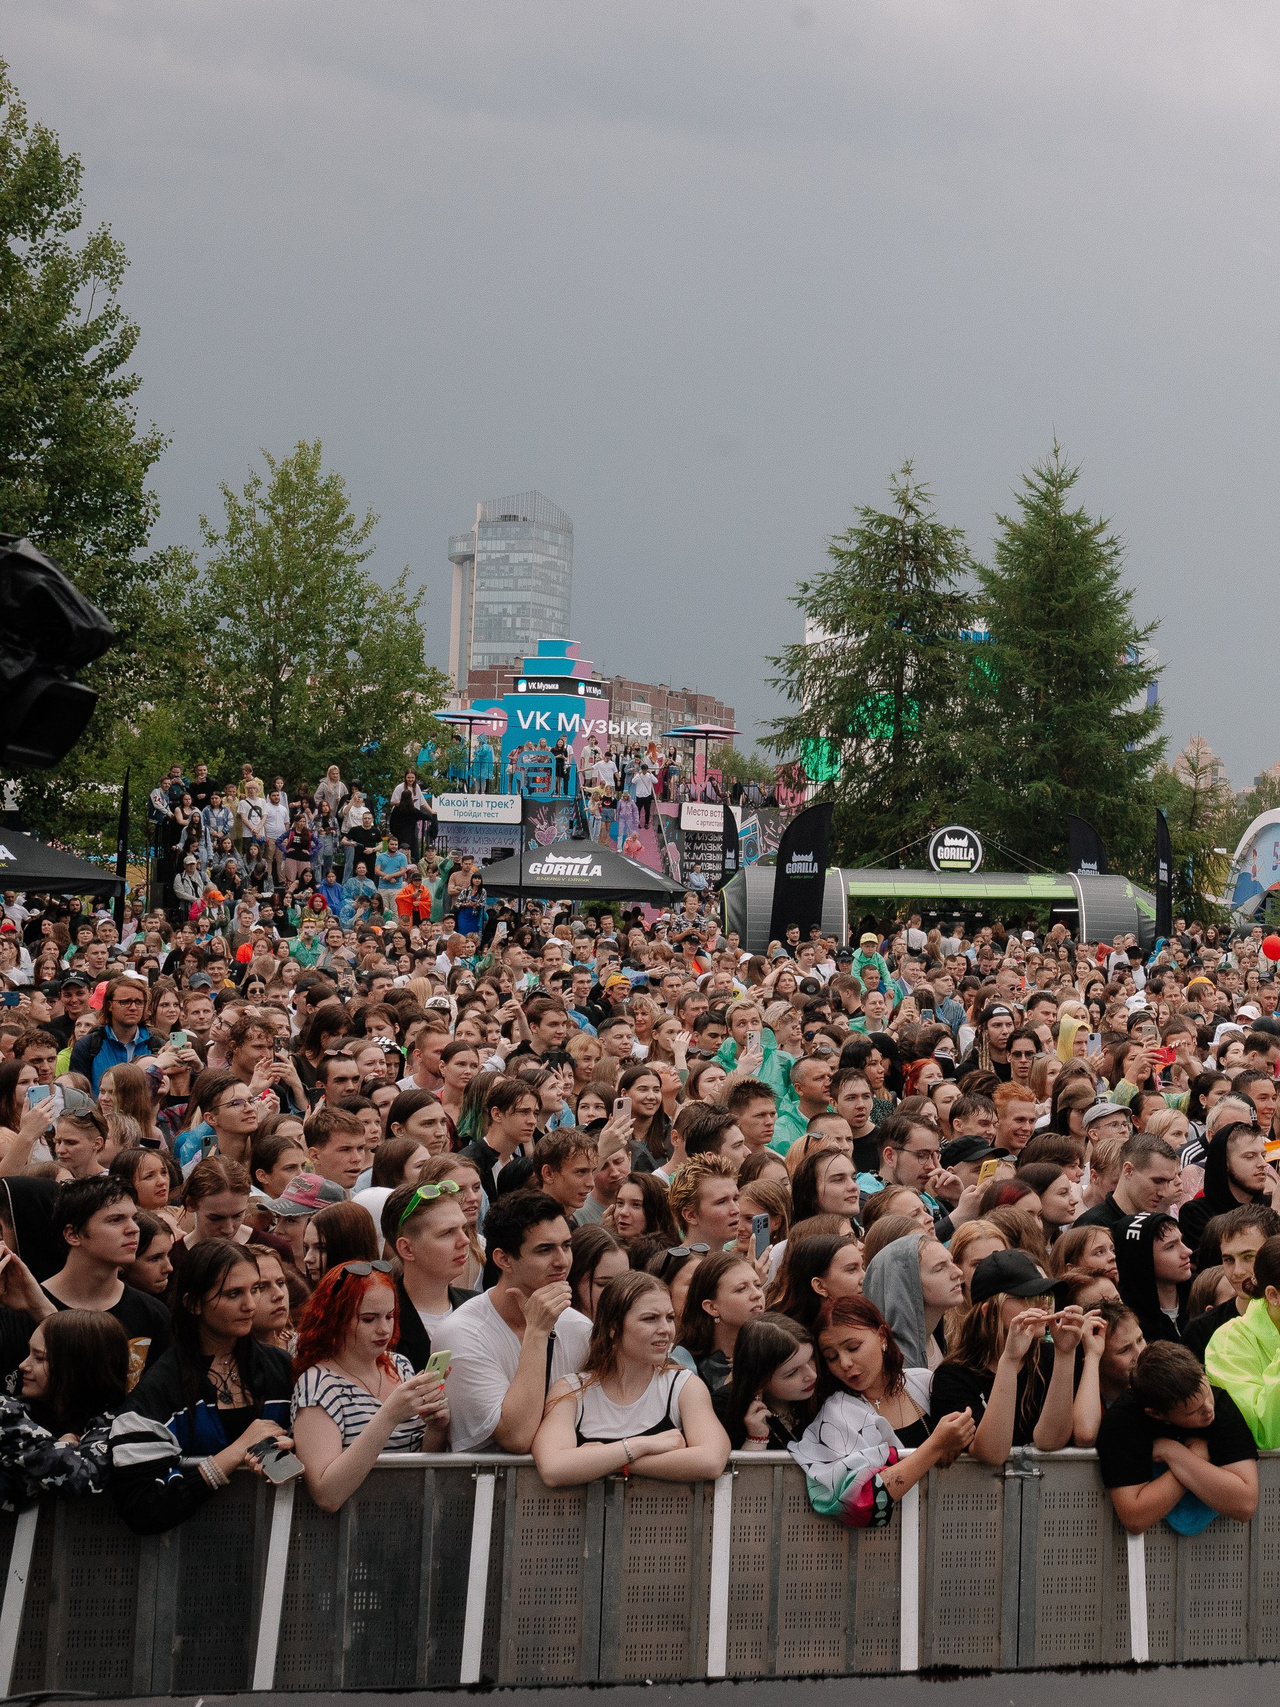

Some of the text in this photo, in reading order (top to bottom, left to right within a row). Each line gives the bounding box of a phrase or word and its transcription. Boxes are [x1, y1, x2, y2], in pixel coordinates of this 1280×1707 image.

[528, 682, 559, 692] VK Музыка
[586, 685, 593, 694] VK
[516, 709, 652, 738] VK Музыка
[438, 797, 515, 810] Какой ты трек?
[453, 809, 482, 818] Пройди
[686, 806, 708, 817] Место
[700, 820, 724, 828] артистам
[695, 832, 724, 842] МУЗЫК
[693, 842, 723, 852] МУЗЫК
[937, 846, 975, 860] GORILLA
[529, 862, 602, 877] GORILLA
[786, 862, 818, 874] GORILLA
